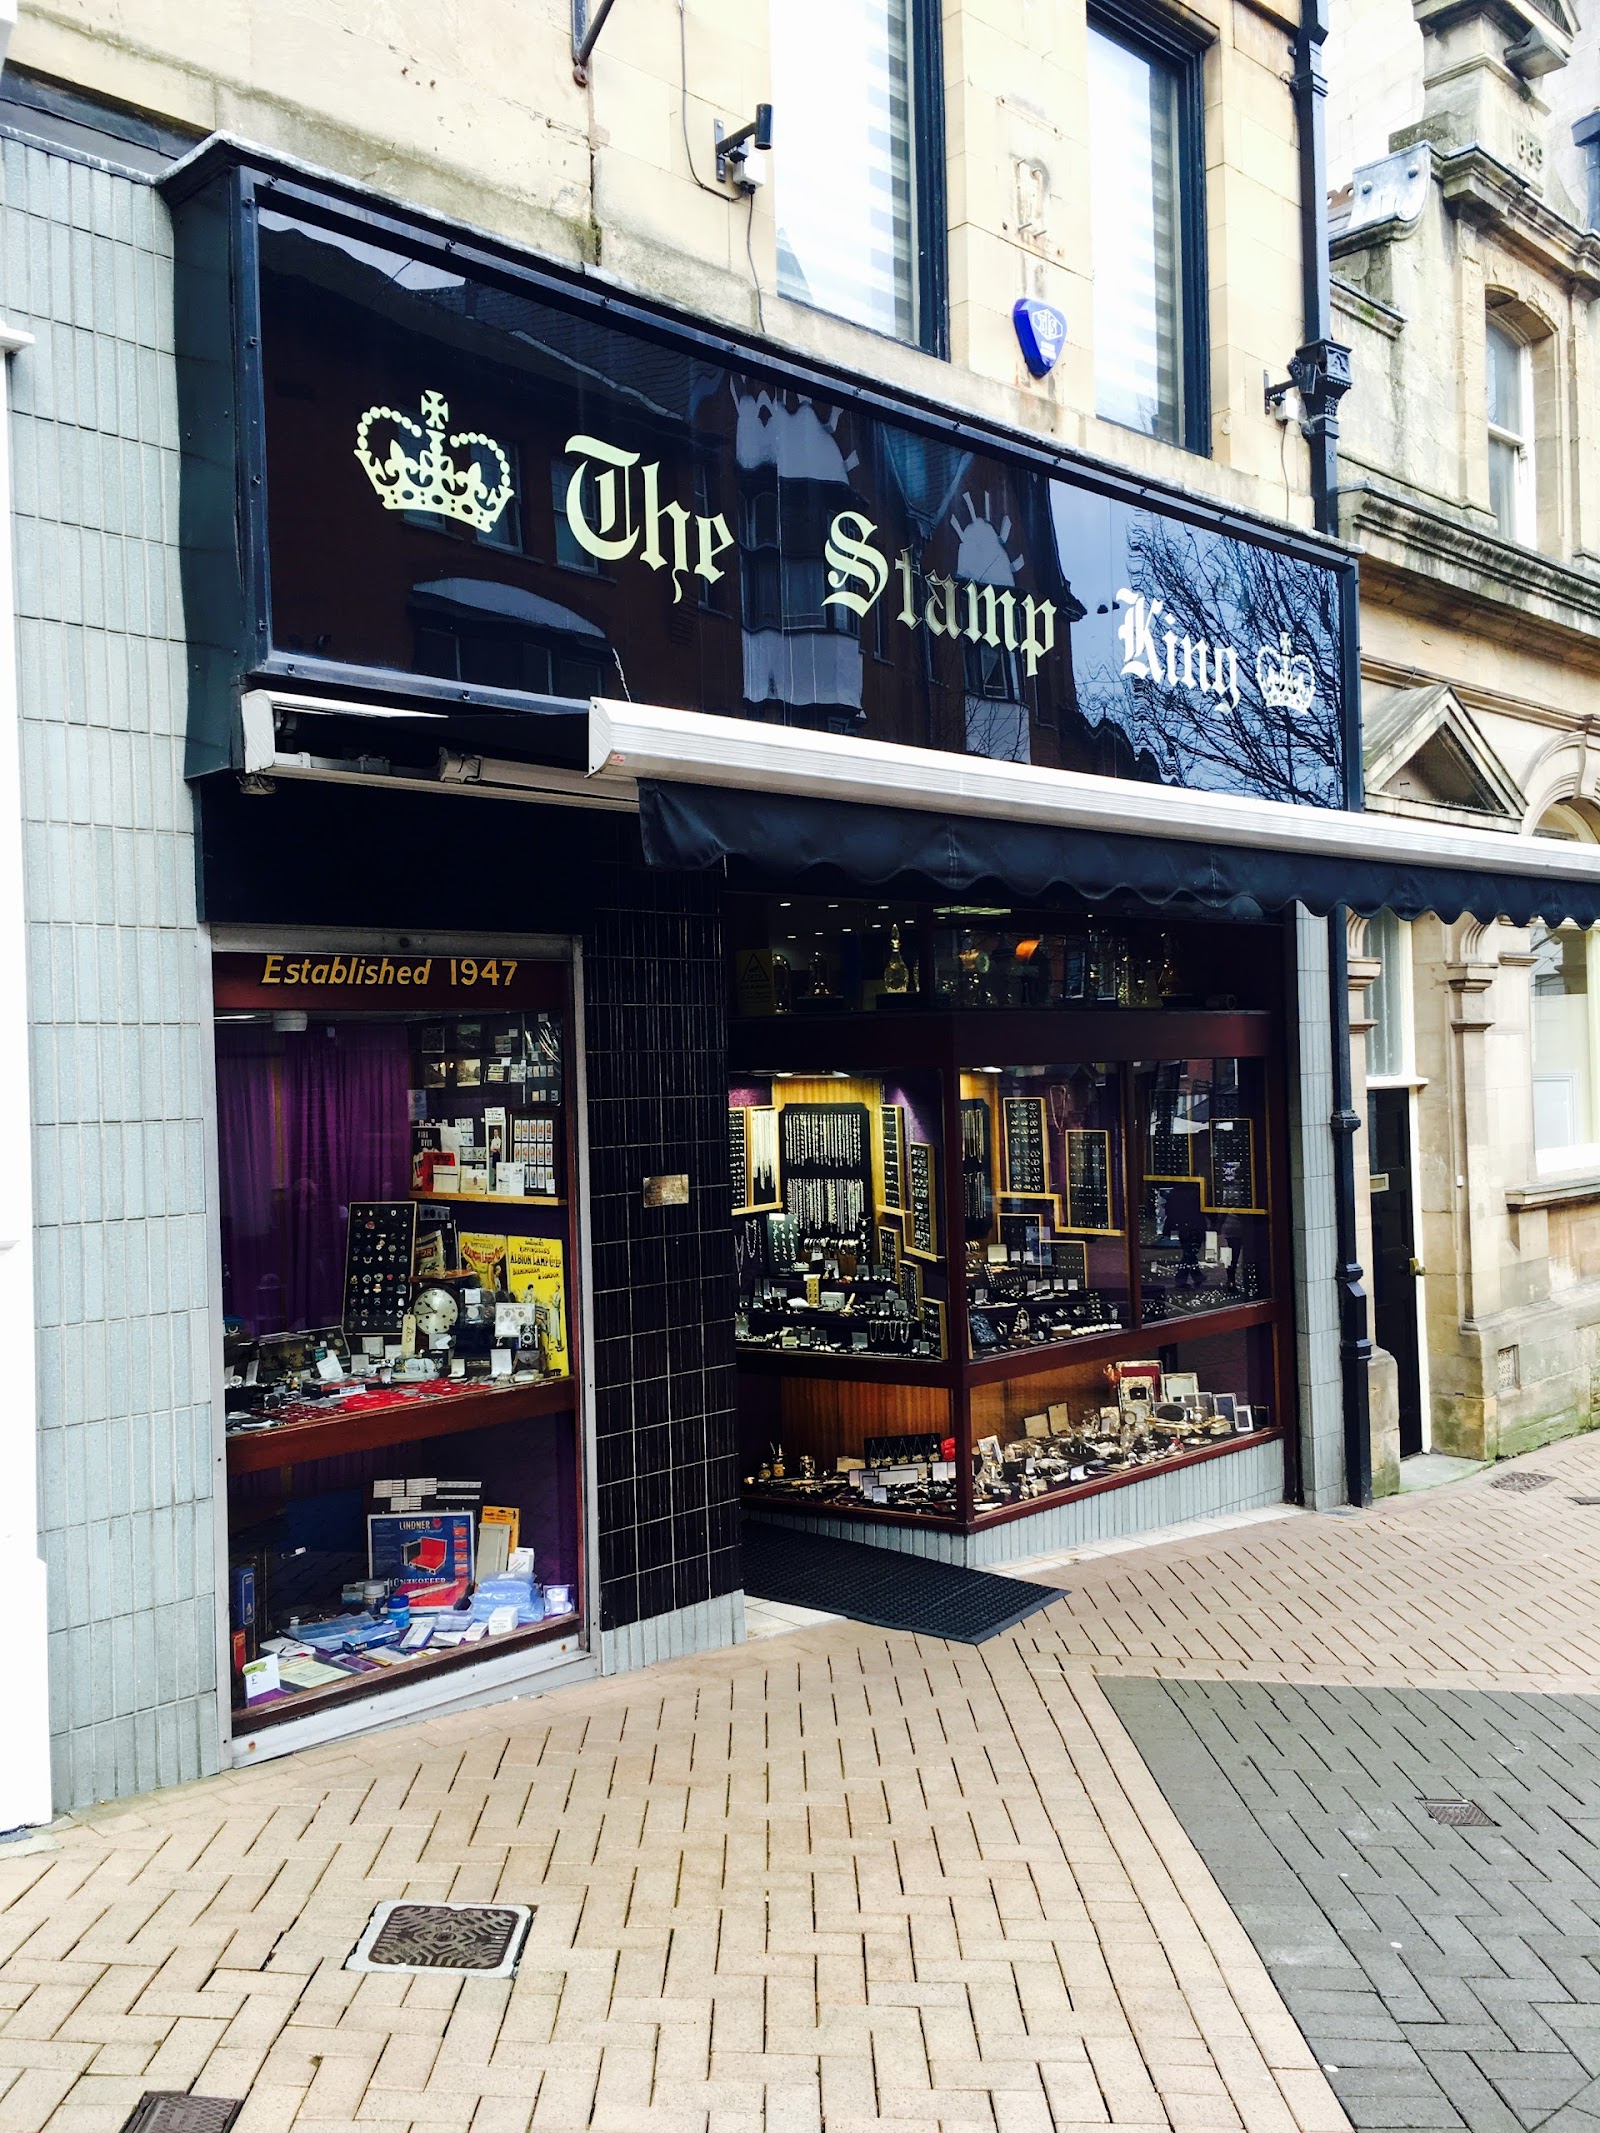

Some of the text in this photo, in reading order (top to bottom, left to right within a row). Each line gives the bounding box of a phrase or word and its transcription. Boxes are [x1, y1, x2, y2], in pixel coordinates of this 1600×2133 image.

[565, 435, 1240, 714] The Stamp King
[261, 955, 518, 986] Established 1947
[399, 1520, 431, 1531] LINDNER
